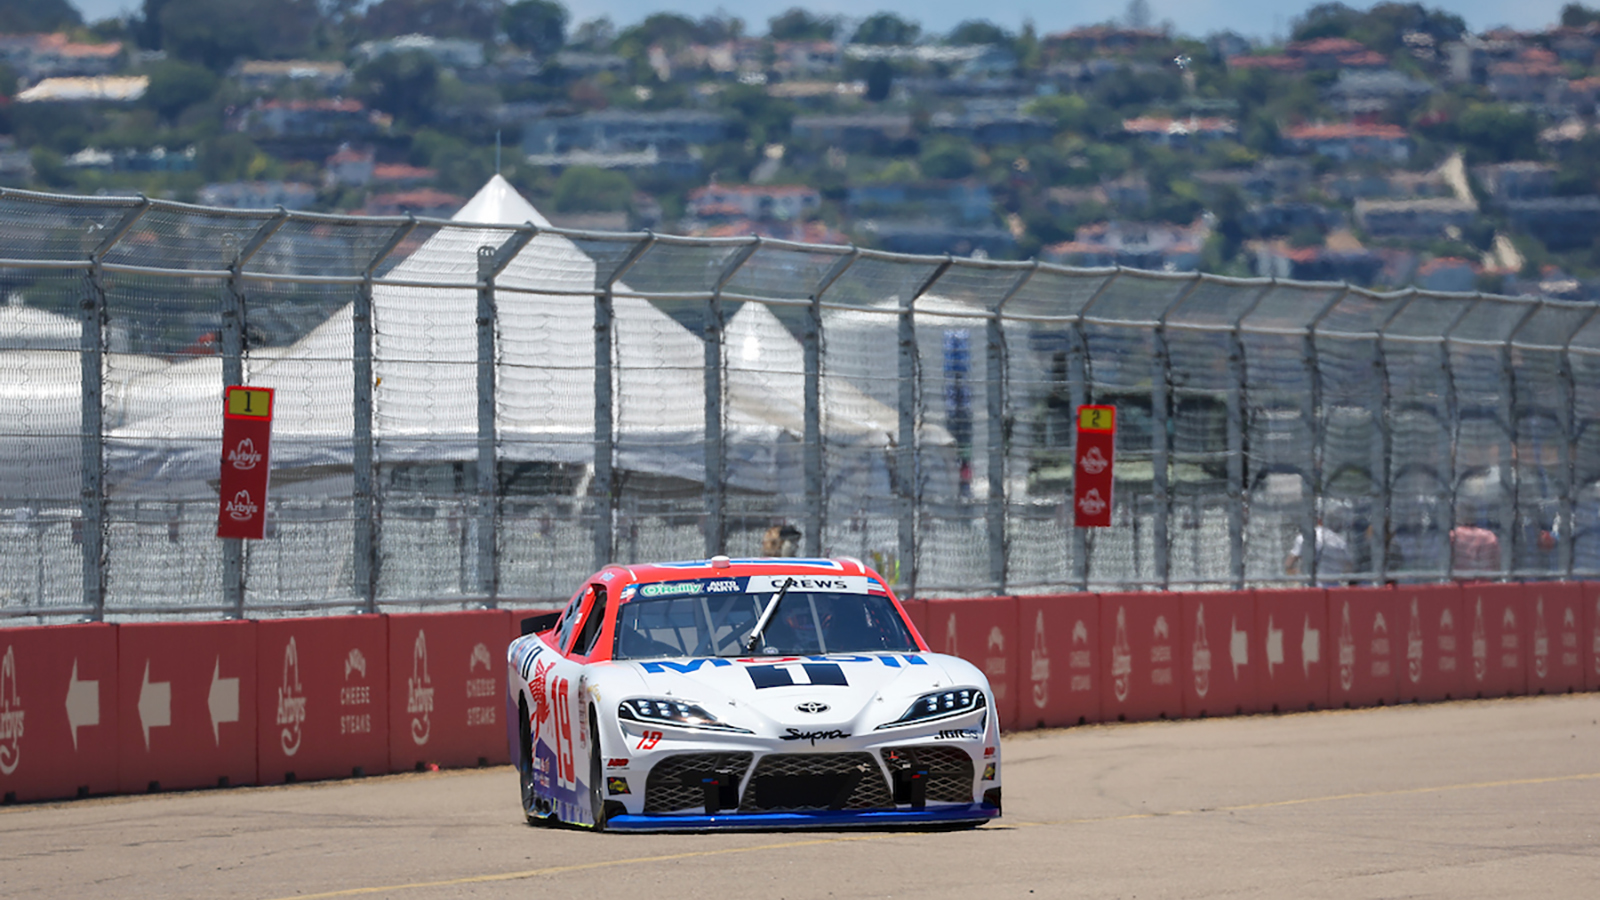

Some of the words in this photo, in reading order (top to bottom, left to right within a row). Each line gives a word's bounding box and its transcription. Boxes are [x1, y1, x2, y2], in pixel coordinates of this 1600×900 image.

[243, 391, 253, 412] 1
[1091, 409, 1100, 428] 2
[228, 449, 262, 465] Arby's
[225, 501, 258, 515] Arby's
[340, 686, 370, 705] CHEESE
[340, 714, 371, 734] STEAKS
[635, 730, 664, 750] 19
[779, 728, 852, 747] Supra
